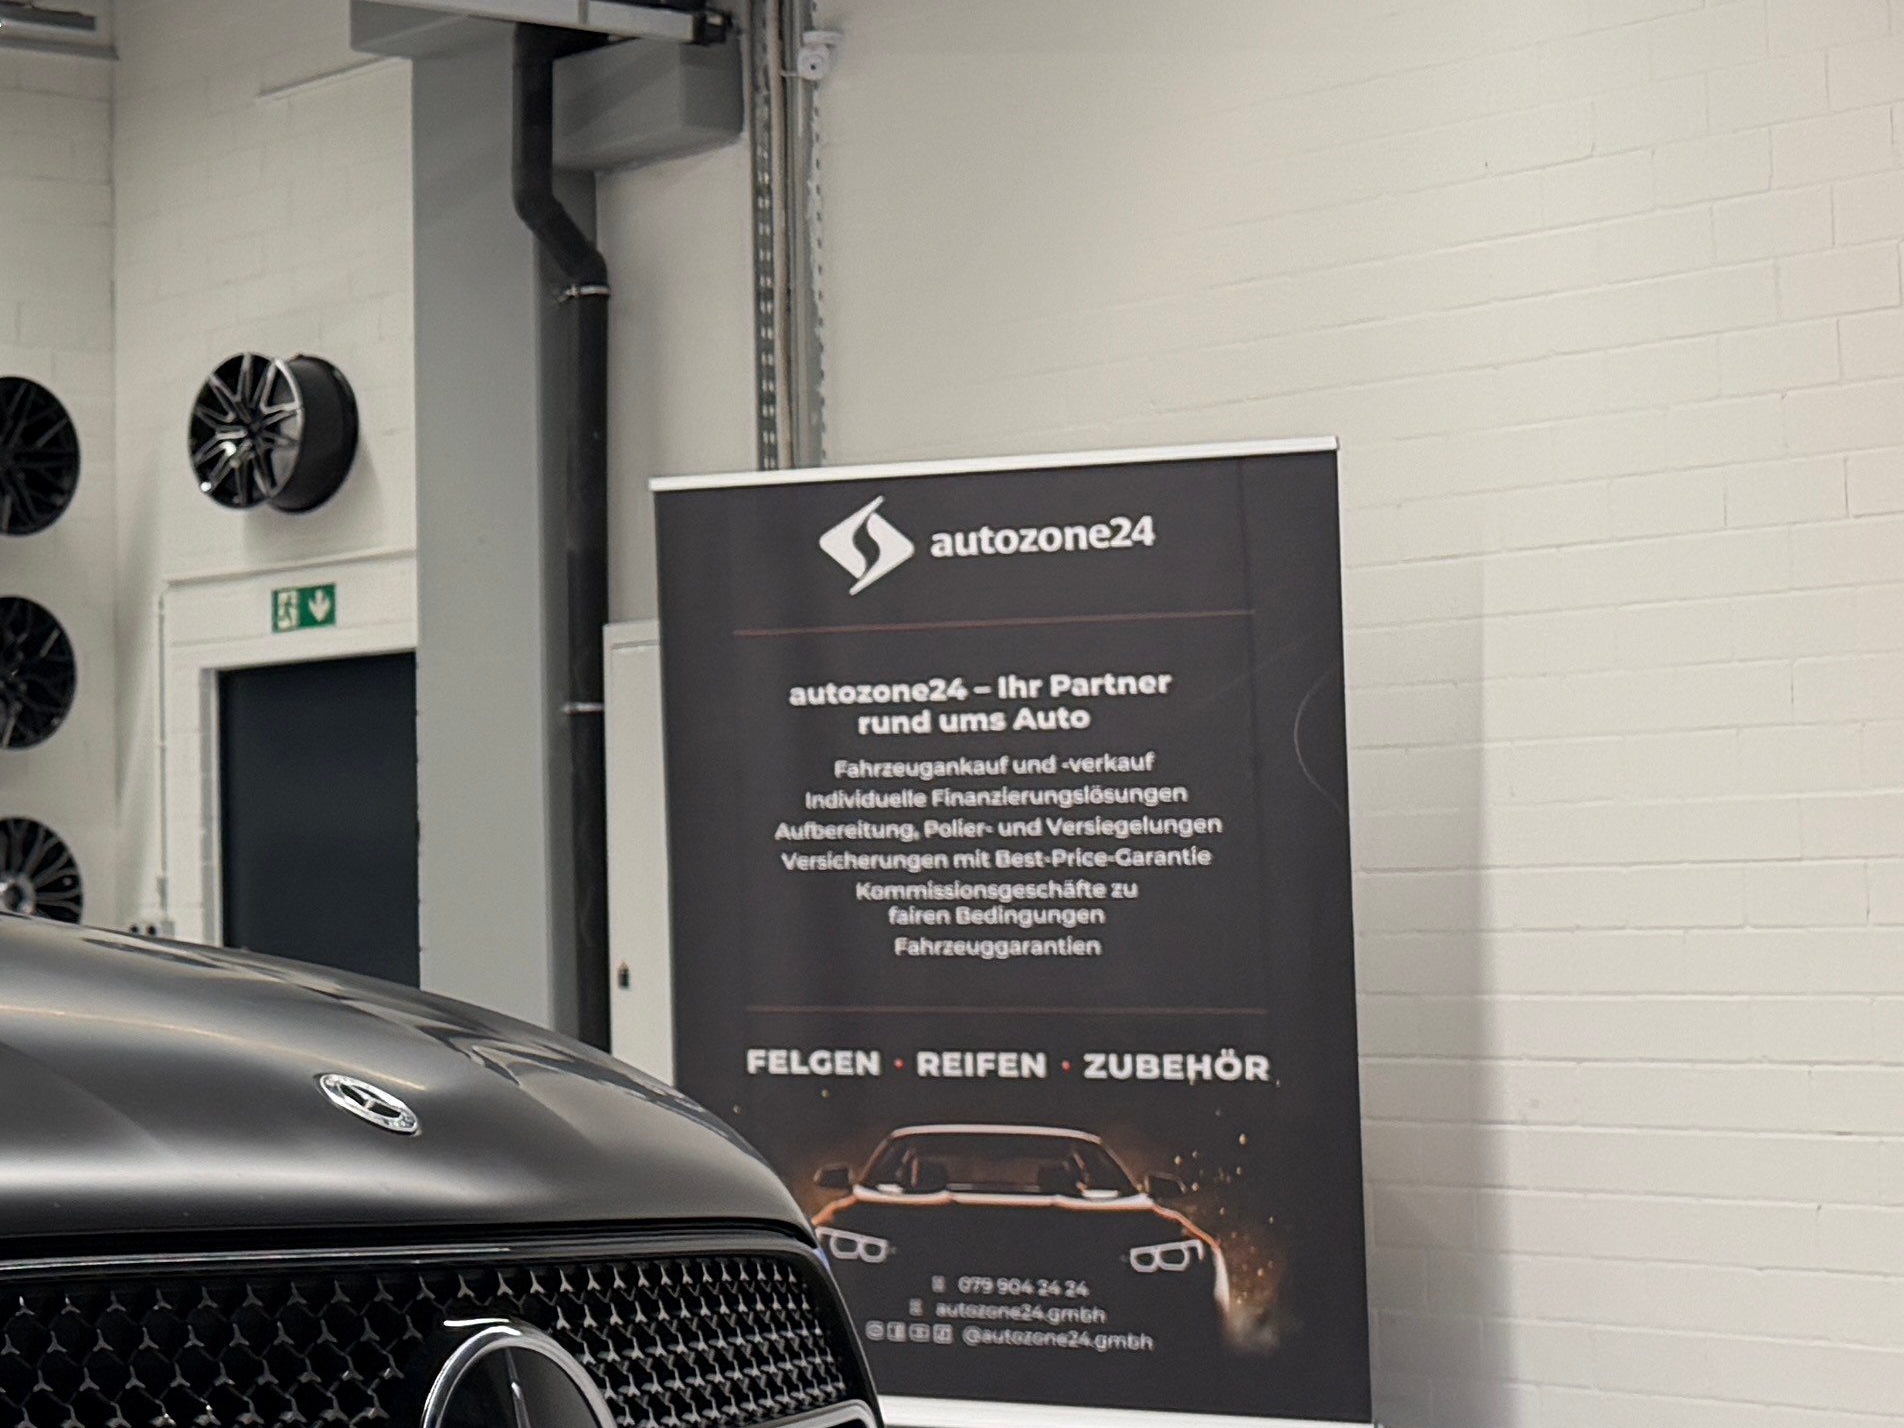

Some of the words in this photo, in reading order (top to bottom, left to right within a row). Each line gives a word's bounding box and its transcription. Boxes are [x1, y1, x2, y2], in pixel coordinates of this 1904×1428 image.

[930, 515, 1156, 558] autozone24
[789, 677, 969, 706] autozone24
[997, 674, 1043, 699] Ihr
[1049, 673, 1173, 698] Partner
[858, 709, 932, 735] rund
[938, 711, 1007, 733] ums
[1012, 706, 1091, 731] Auto
[834, 755, 1010, 781] Fahrzeugankauf
[1012, 754, 1057, 775] und
[1061, 751, 1155, 773] -verkauf
[805, 788, 928, 810] Individuelle
[931, 784, 1189, 809] Finanzierungslösungen
[774, 819, 920, 843] Aufbereitung,
[923, 818, 994, 839] Polier-
[997, 817, 1043, 838] und
[1045, 815, 1223, 839] Versiegelungen
[780, 850, 950, 873] Versicherungen
[952, 848, 991, 869] mit
[994, 845, 1212, 869] Best-Price-Garantie
[855, 878, 1107, 904] Kommissionsgeschäfte
[1110, 882, 1139, 899] zu
[888, 905, 952, 926] fairen
[955, 904, 1106, 929] Bedingungen
[894, 935, 1102, 960] Fahrzeuggarantien
[746, 1048, 881, 1076] FELGEN
[916, 1051, 1047, 1078] REIFEN
[1083, 1048, 1270, 1080] ZUBEHÖR
